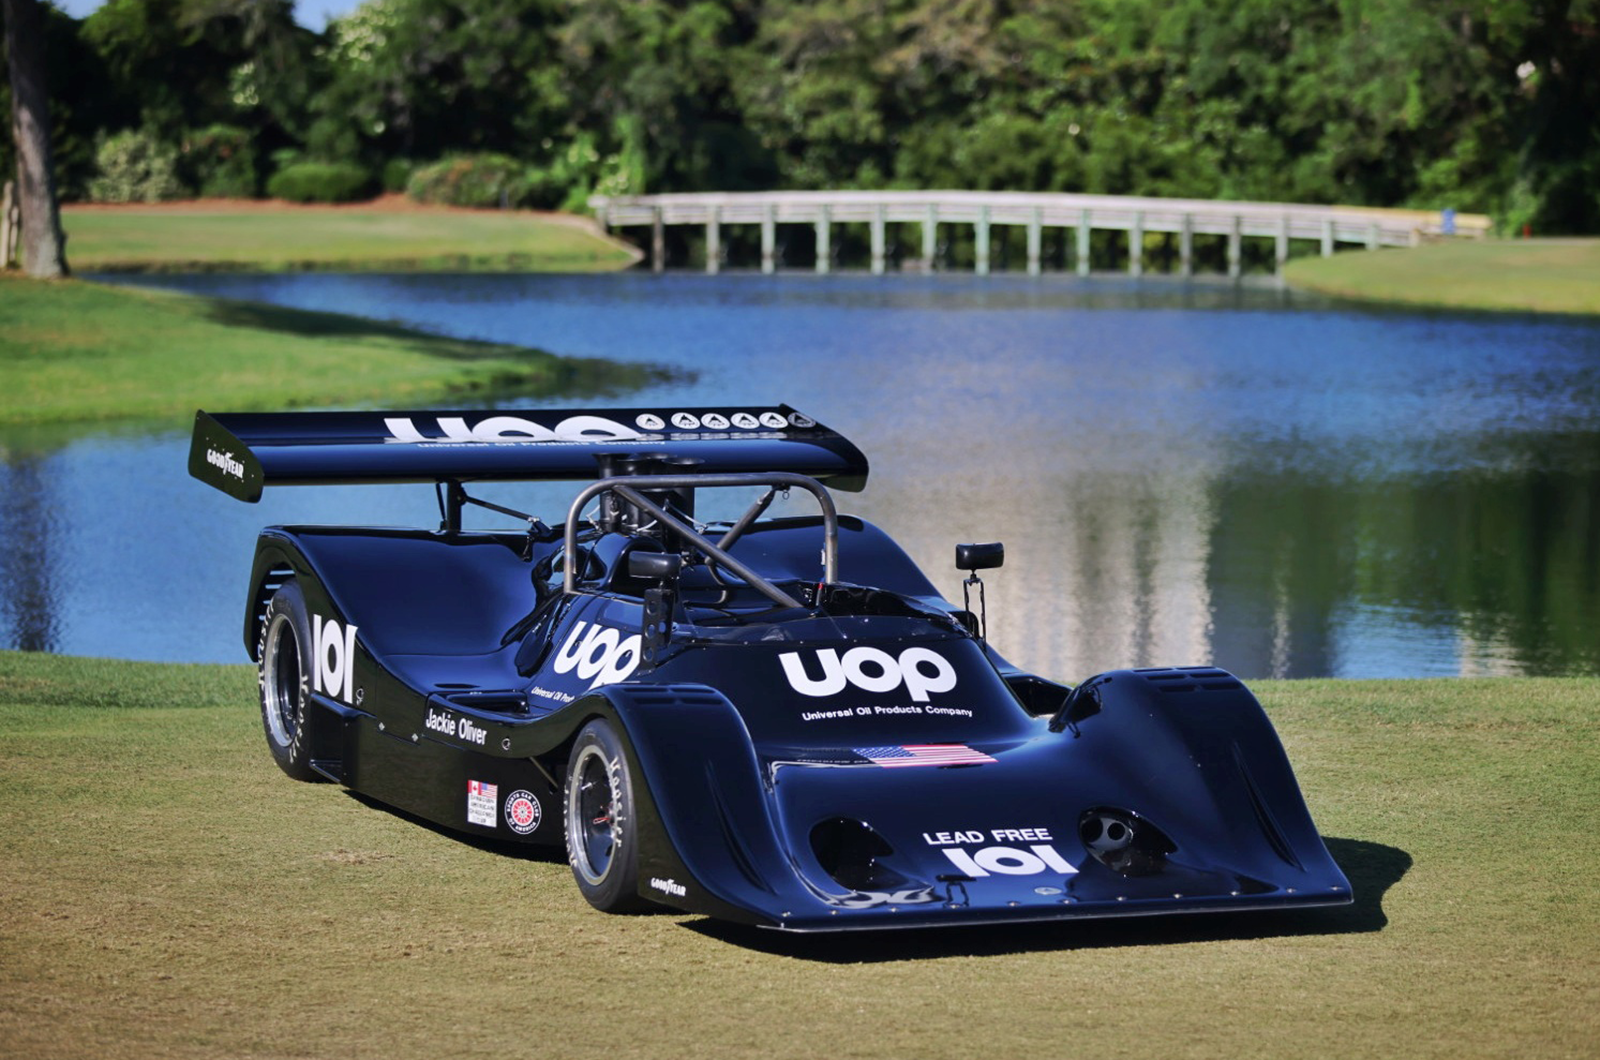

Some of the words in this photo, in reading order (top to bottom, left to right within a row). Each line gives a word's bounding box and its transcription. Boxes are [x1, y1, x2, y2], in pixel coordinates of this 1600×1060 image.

[313, 613, 358, 705] 101
[530, 685, 556, 699] Universal
[553, 690, 564, 701] Oil
[802, 708, 854, 721] Universal
[856, 705, 872, 716] Oil
[874, 704, 923, 715] Products
[925, 705, 973, 718] Company
[425, 708, 456, 736] Jackie
[458, 717, 488, 746] Oliver
[922, 830, 985, 845] LEAD
[990, 827, 1053, 842] FREE
[942, 844, 1080, 878] 101
